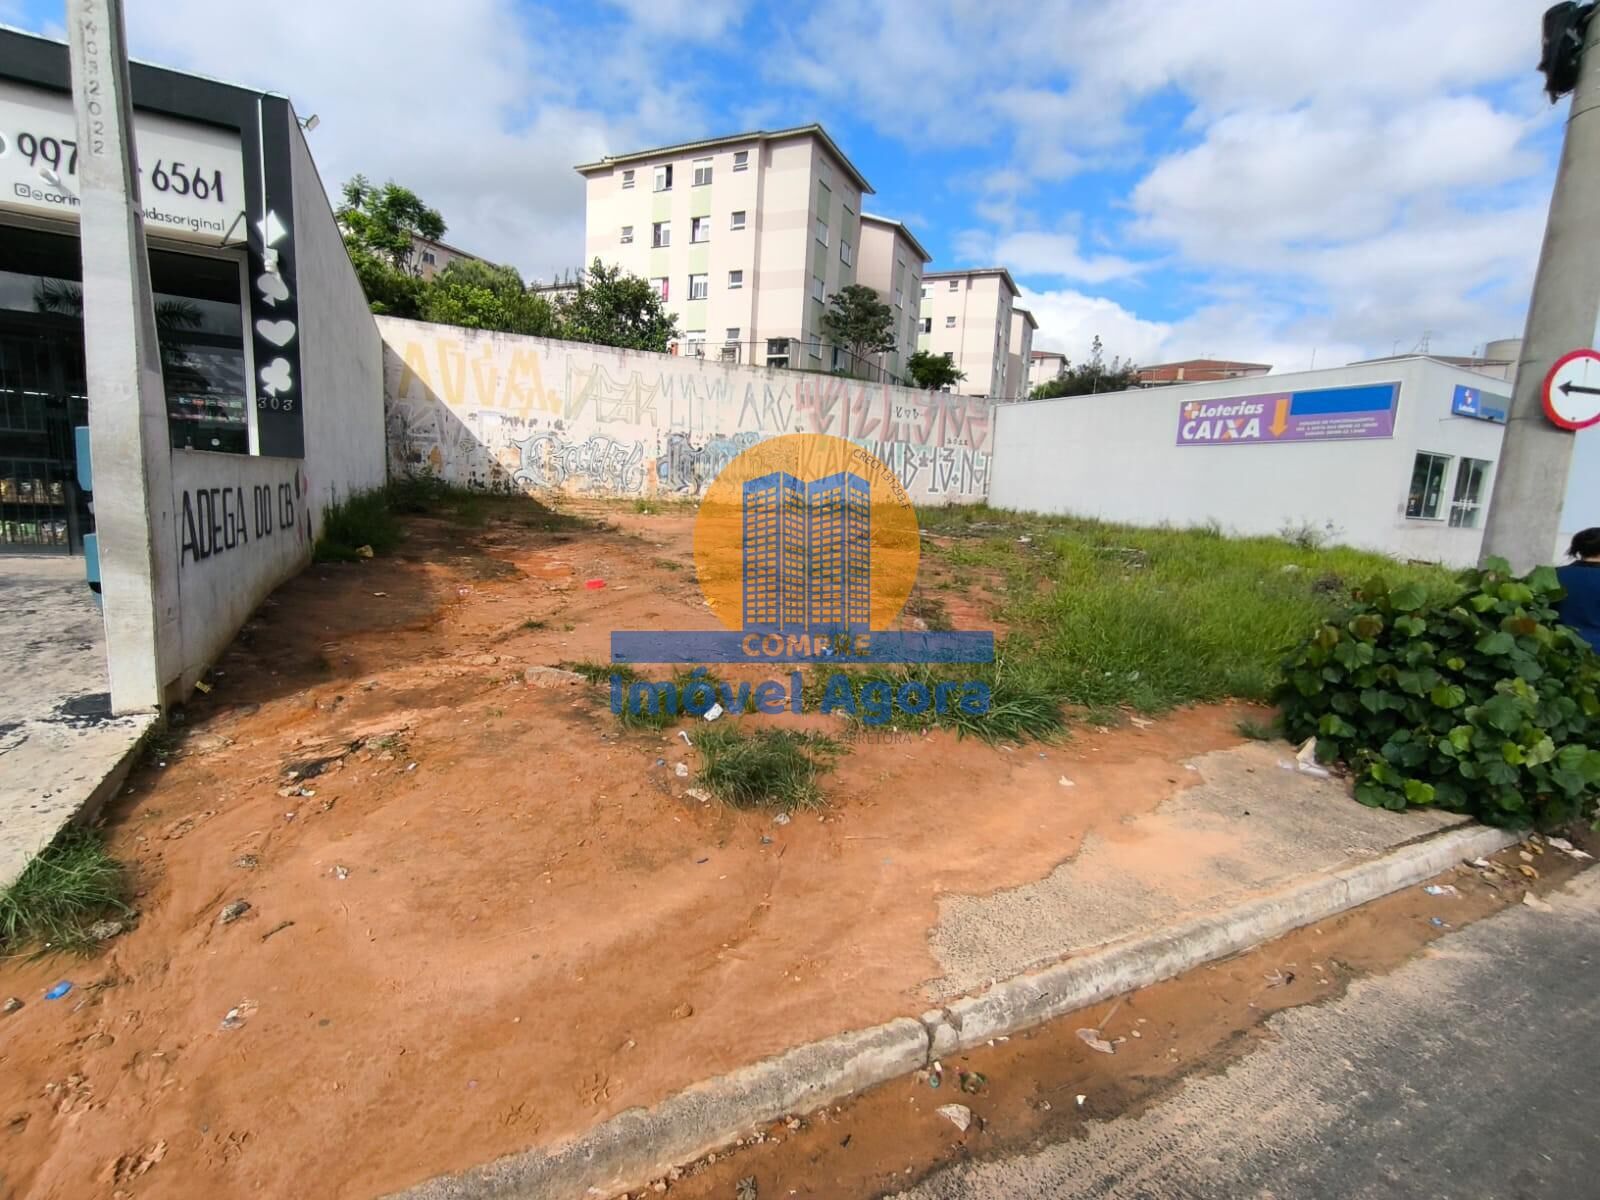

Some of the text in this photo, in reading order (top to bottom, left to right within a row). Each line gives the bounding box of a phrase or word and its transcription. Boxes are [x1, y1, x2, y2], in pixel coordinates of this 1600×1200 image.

[18, 132, 224, 202] 997 6561
[258, 397, 293, 411] 303
[1200, 401, 1264, 417] Loterias
[1182, 418, 1260, 441] CAIXA
[181, 482, 294, 568] ADEGA DO CB
